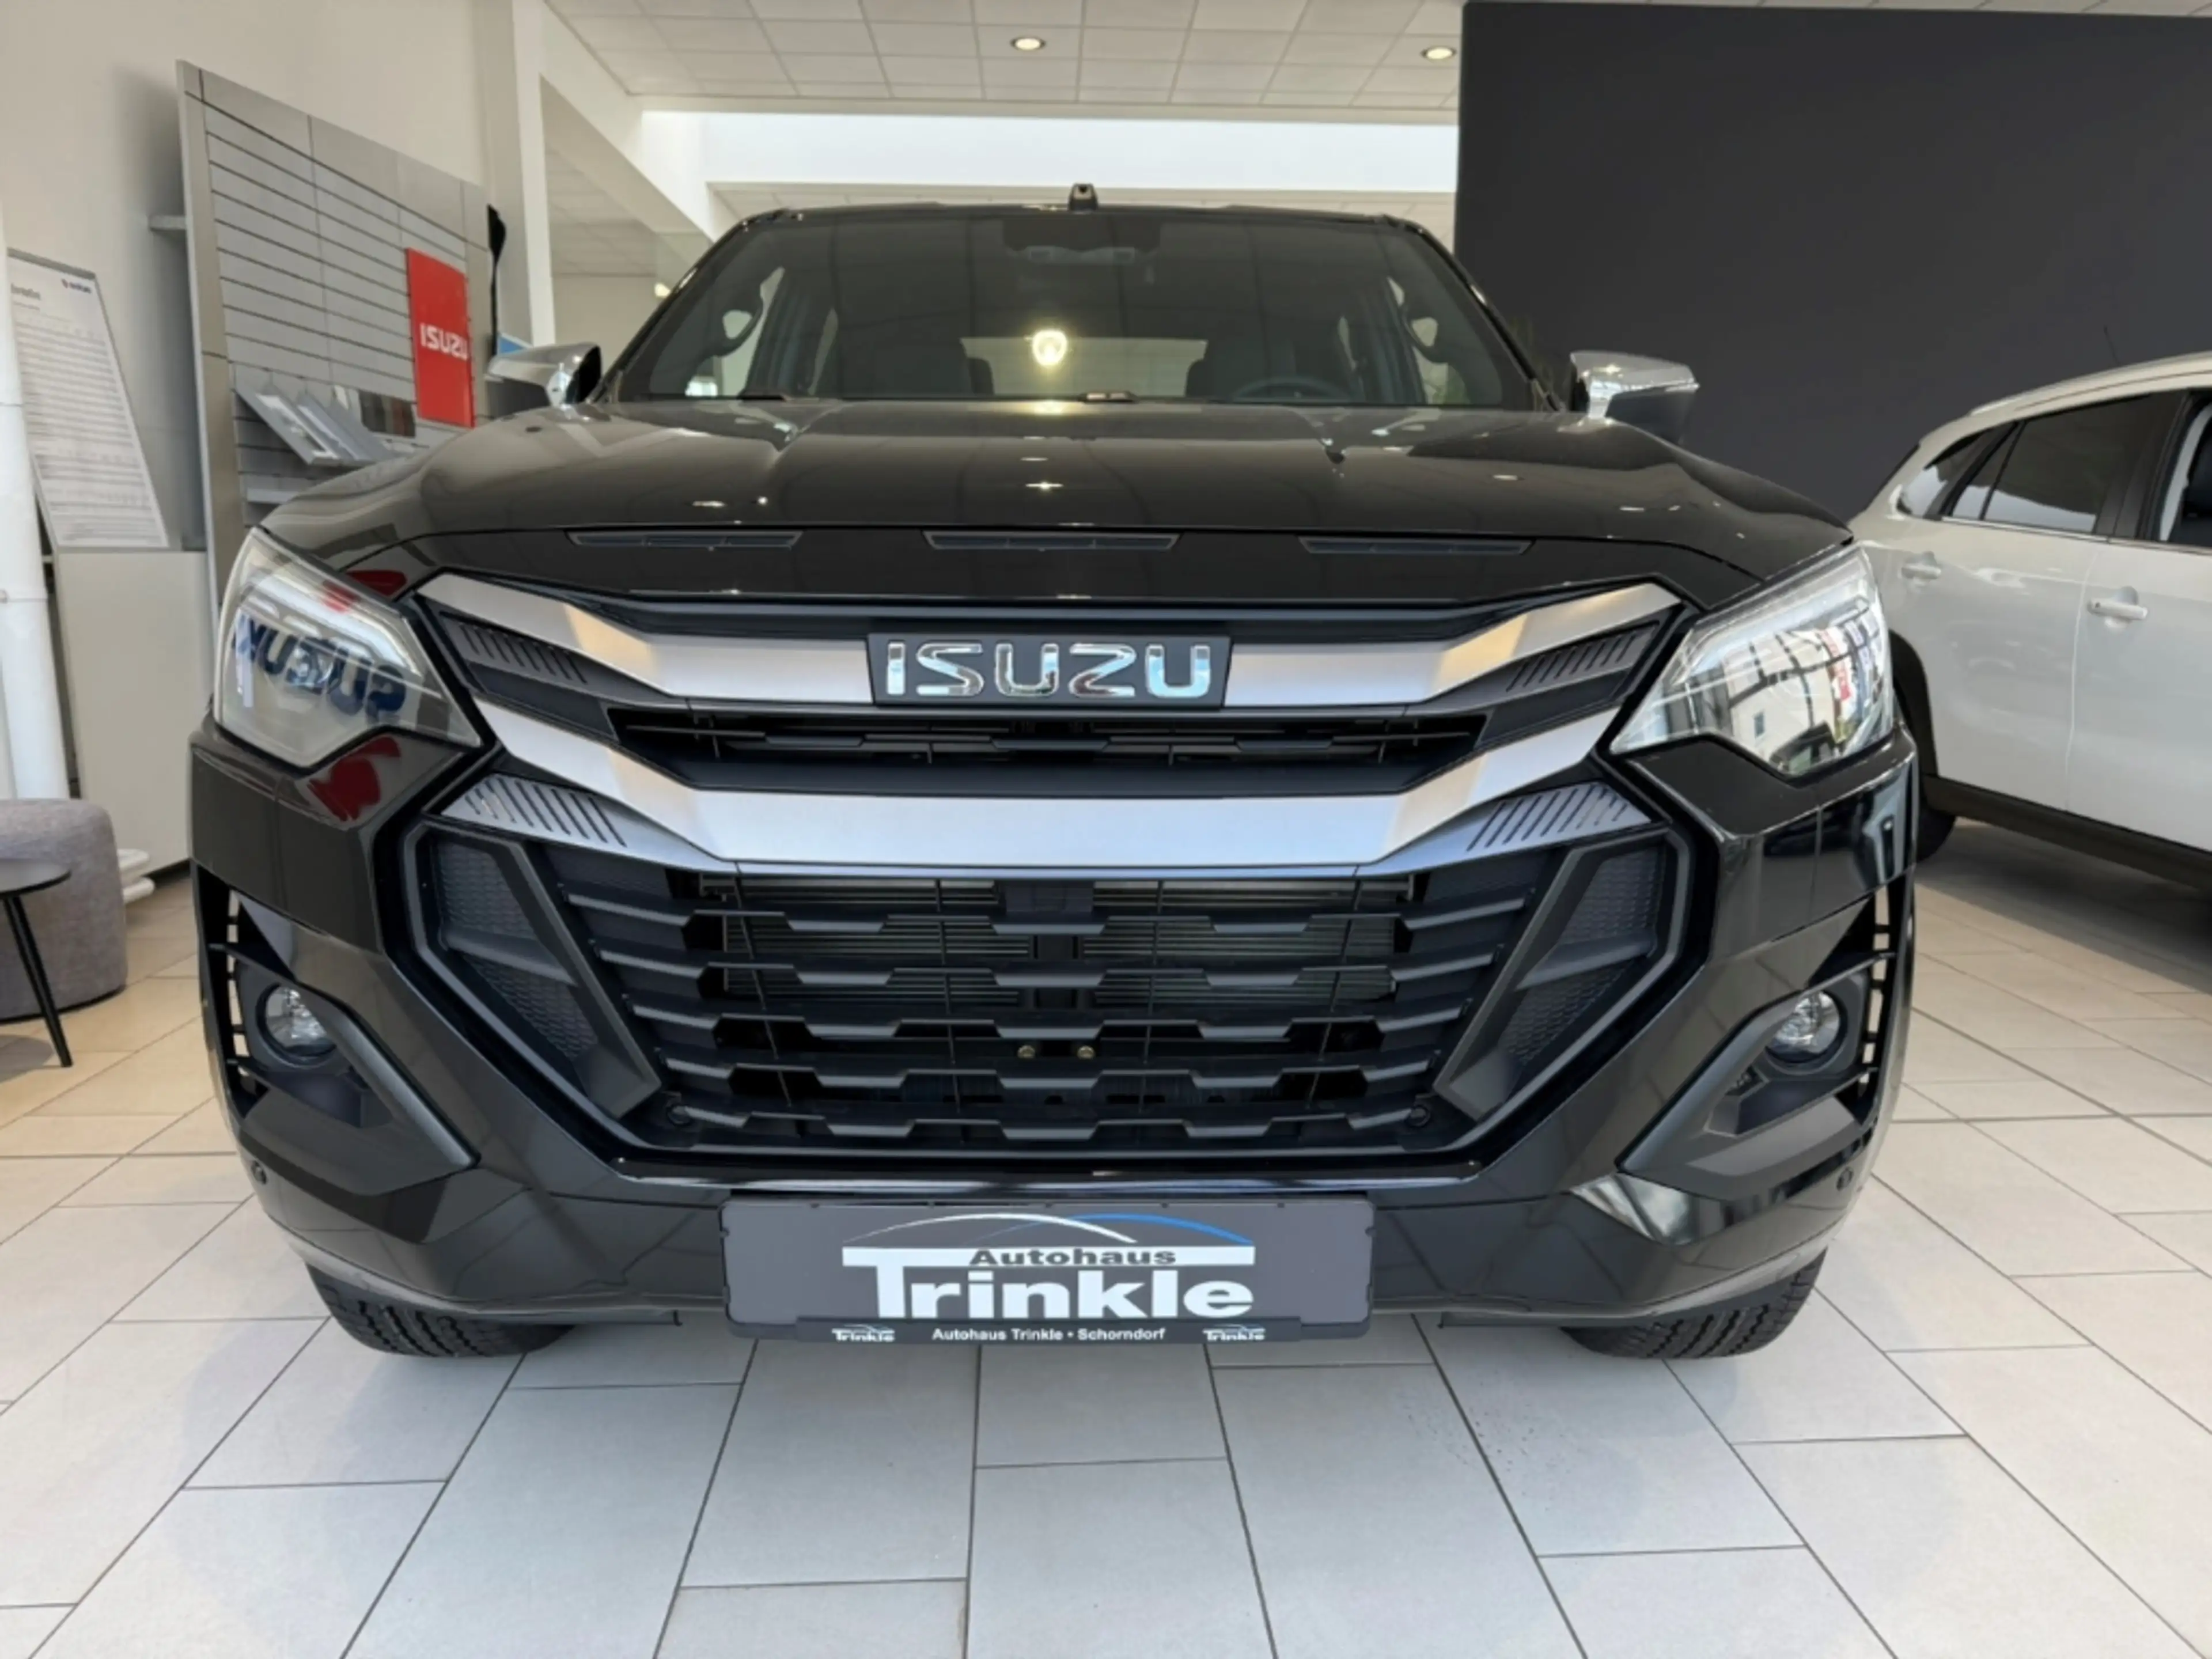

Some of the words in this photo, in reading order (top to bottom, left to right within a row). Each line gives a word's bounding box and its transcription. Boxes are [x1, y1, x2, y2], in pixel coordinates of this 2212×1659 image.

[419, 322, 468, 361] ISUZU
[887, 642, 1210, 698] ISUZU
[969, 1248, 1176, 1266] Autohaus
[842, 1246, 1256, 1319] Trinkle
[832, 1327, 895, 1342] Trinkle
[931, 1328, 1007, 1342] Autohaus
[1010, 1328, 1063, 1342] Trinkle
[1077, 1327, 1166, 1342] Schorndorf
[1202, 1327, 1266, 1342] Trinkle
